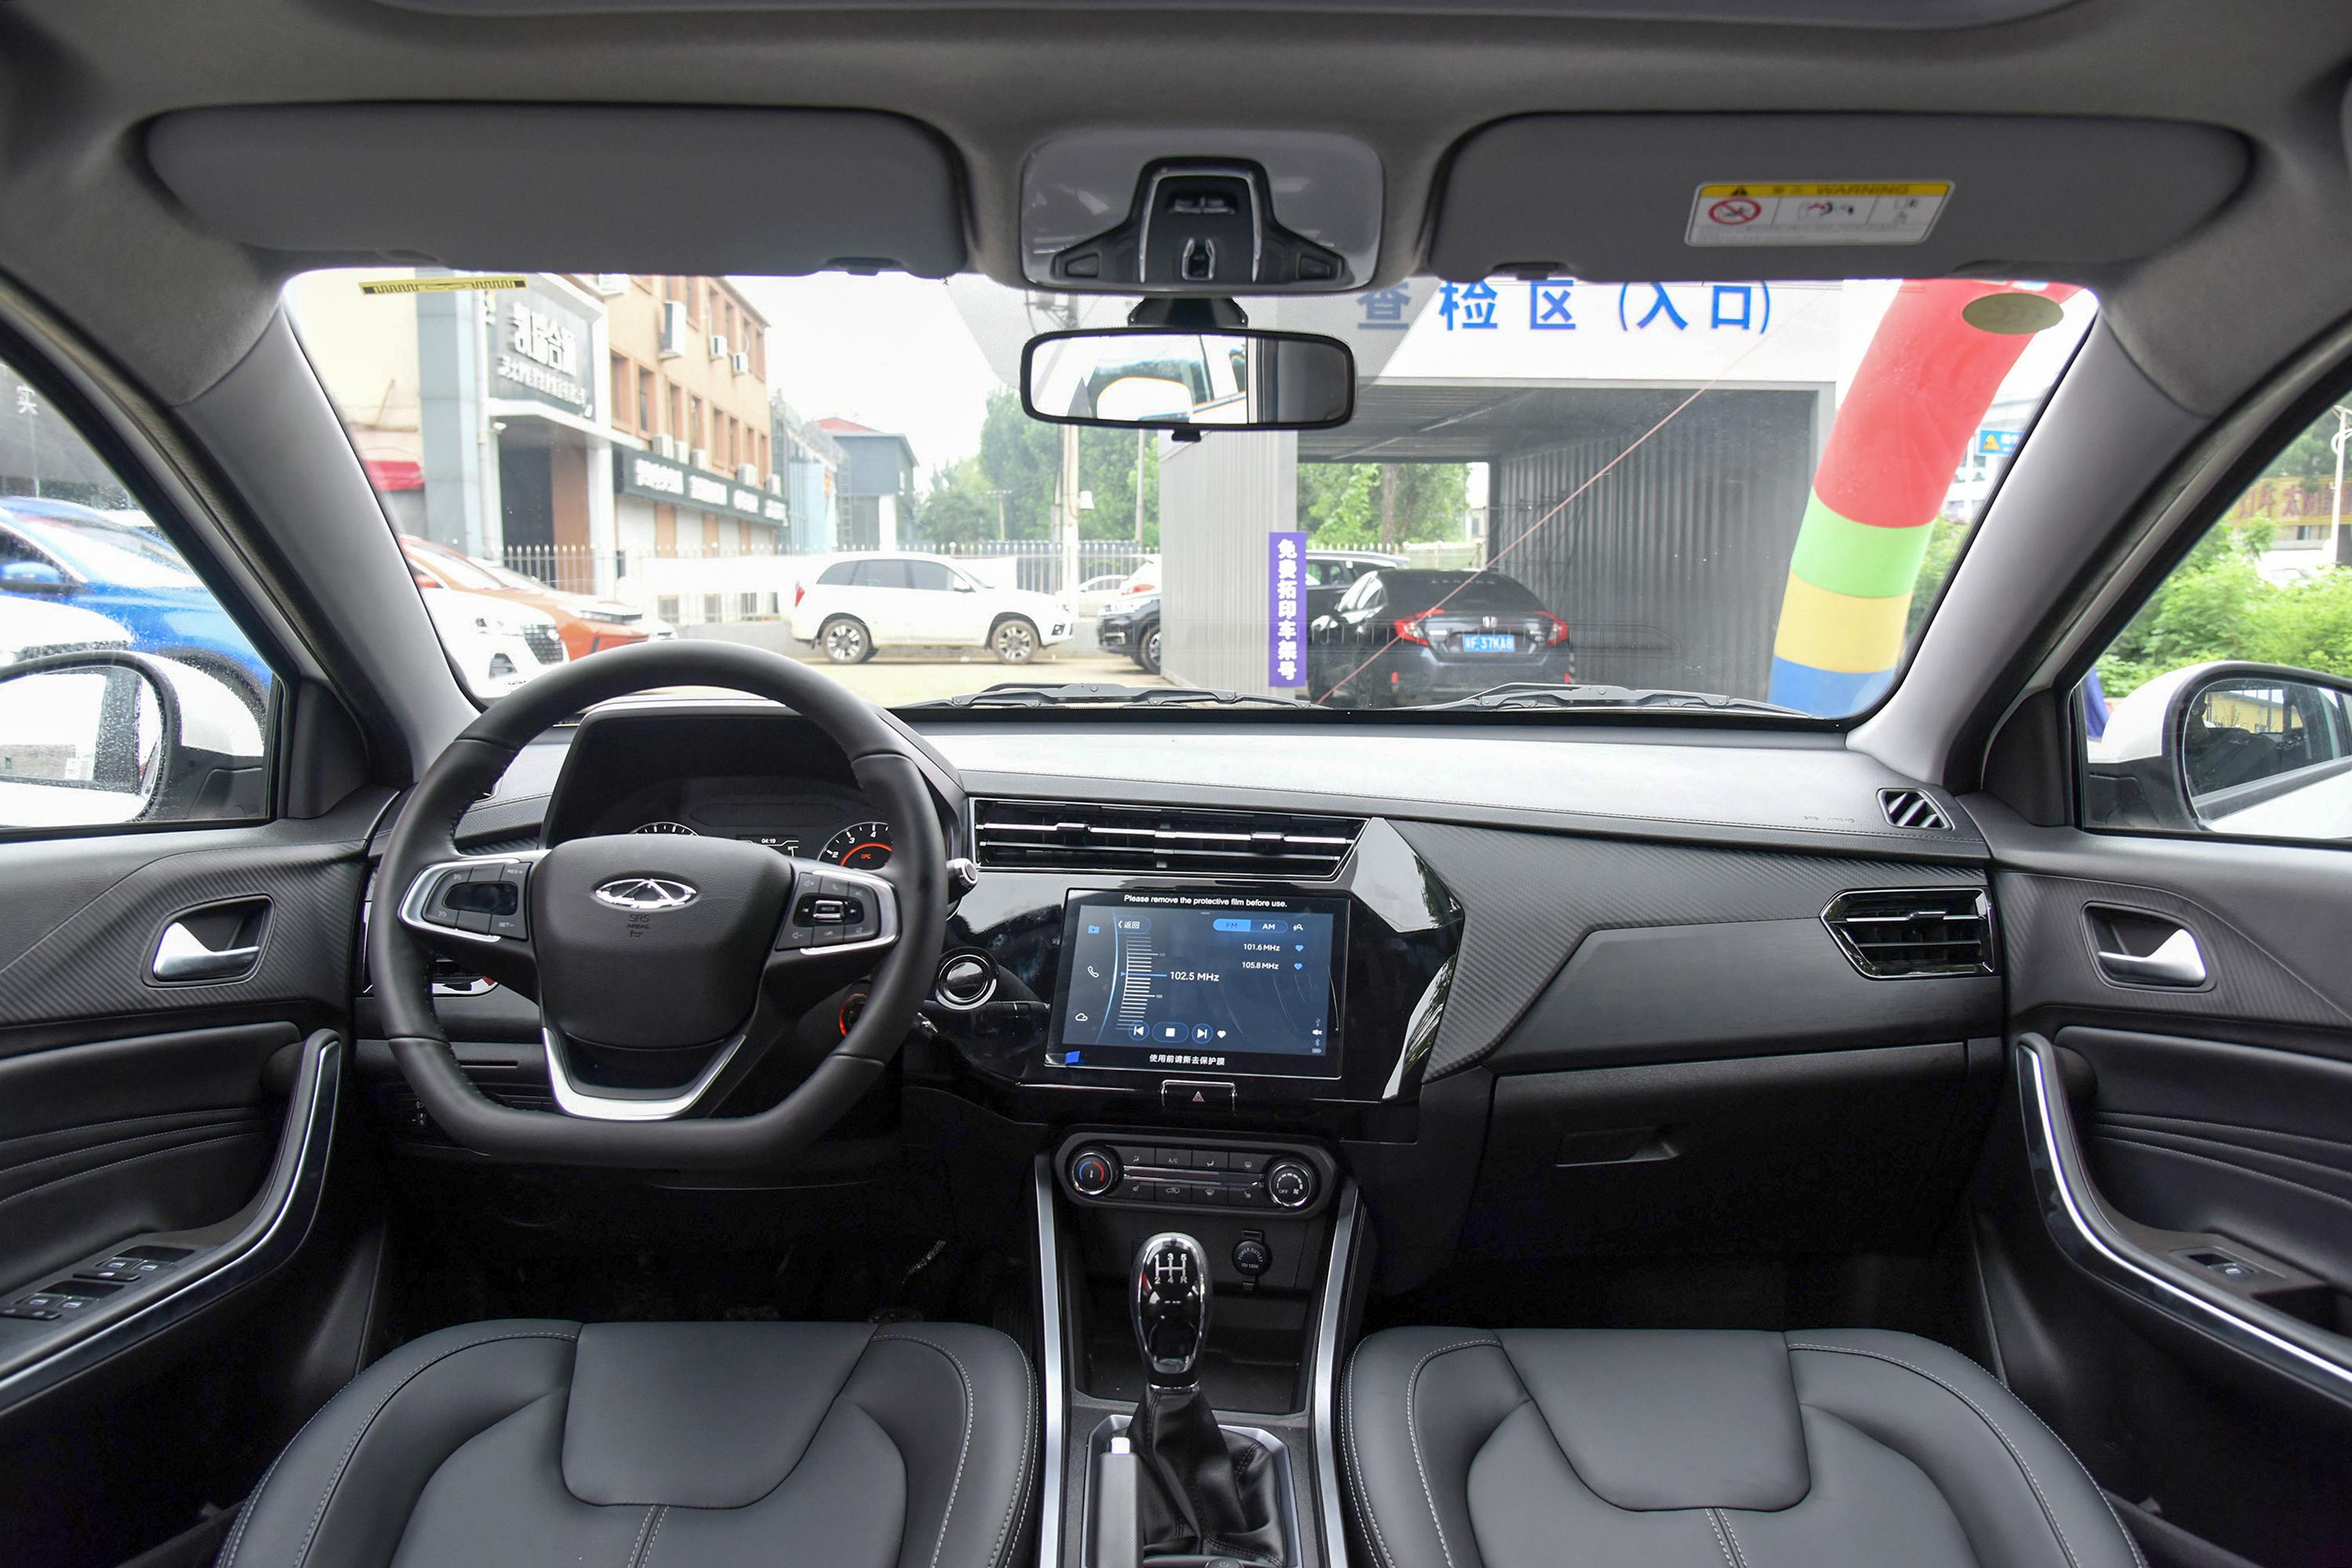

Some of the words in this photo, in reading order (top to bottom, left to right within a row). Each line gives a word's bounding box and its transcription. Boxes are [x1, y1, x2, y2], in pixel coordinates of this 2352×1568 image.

[1816, 184, 1910, 195] WARNING
[1277, 539, 1298, 681] 免费拓印车架号
[1124, 920, 1141, 929] 返回
[1170, 971, 1195, 981] 102.5
[1196, 972, 1220, 982] MHz
[1149, 1054, 1225, 1066] 使用前请撕去保护膜
[1237, 1247, 1250, 1260] POWER
